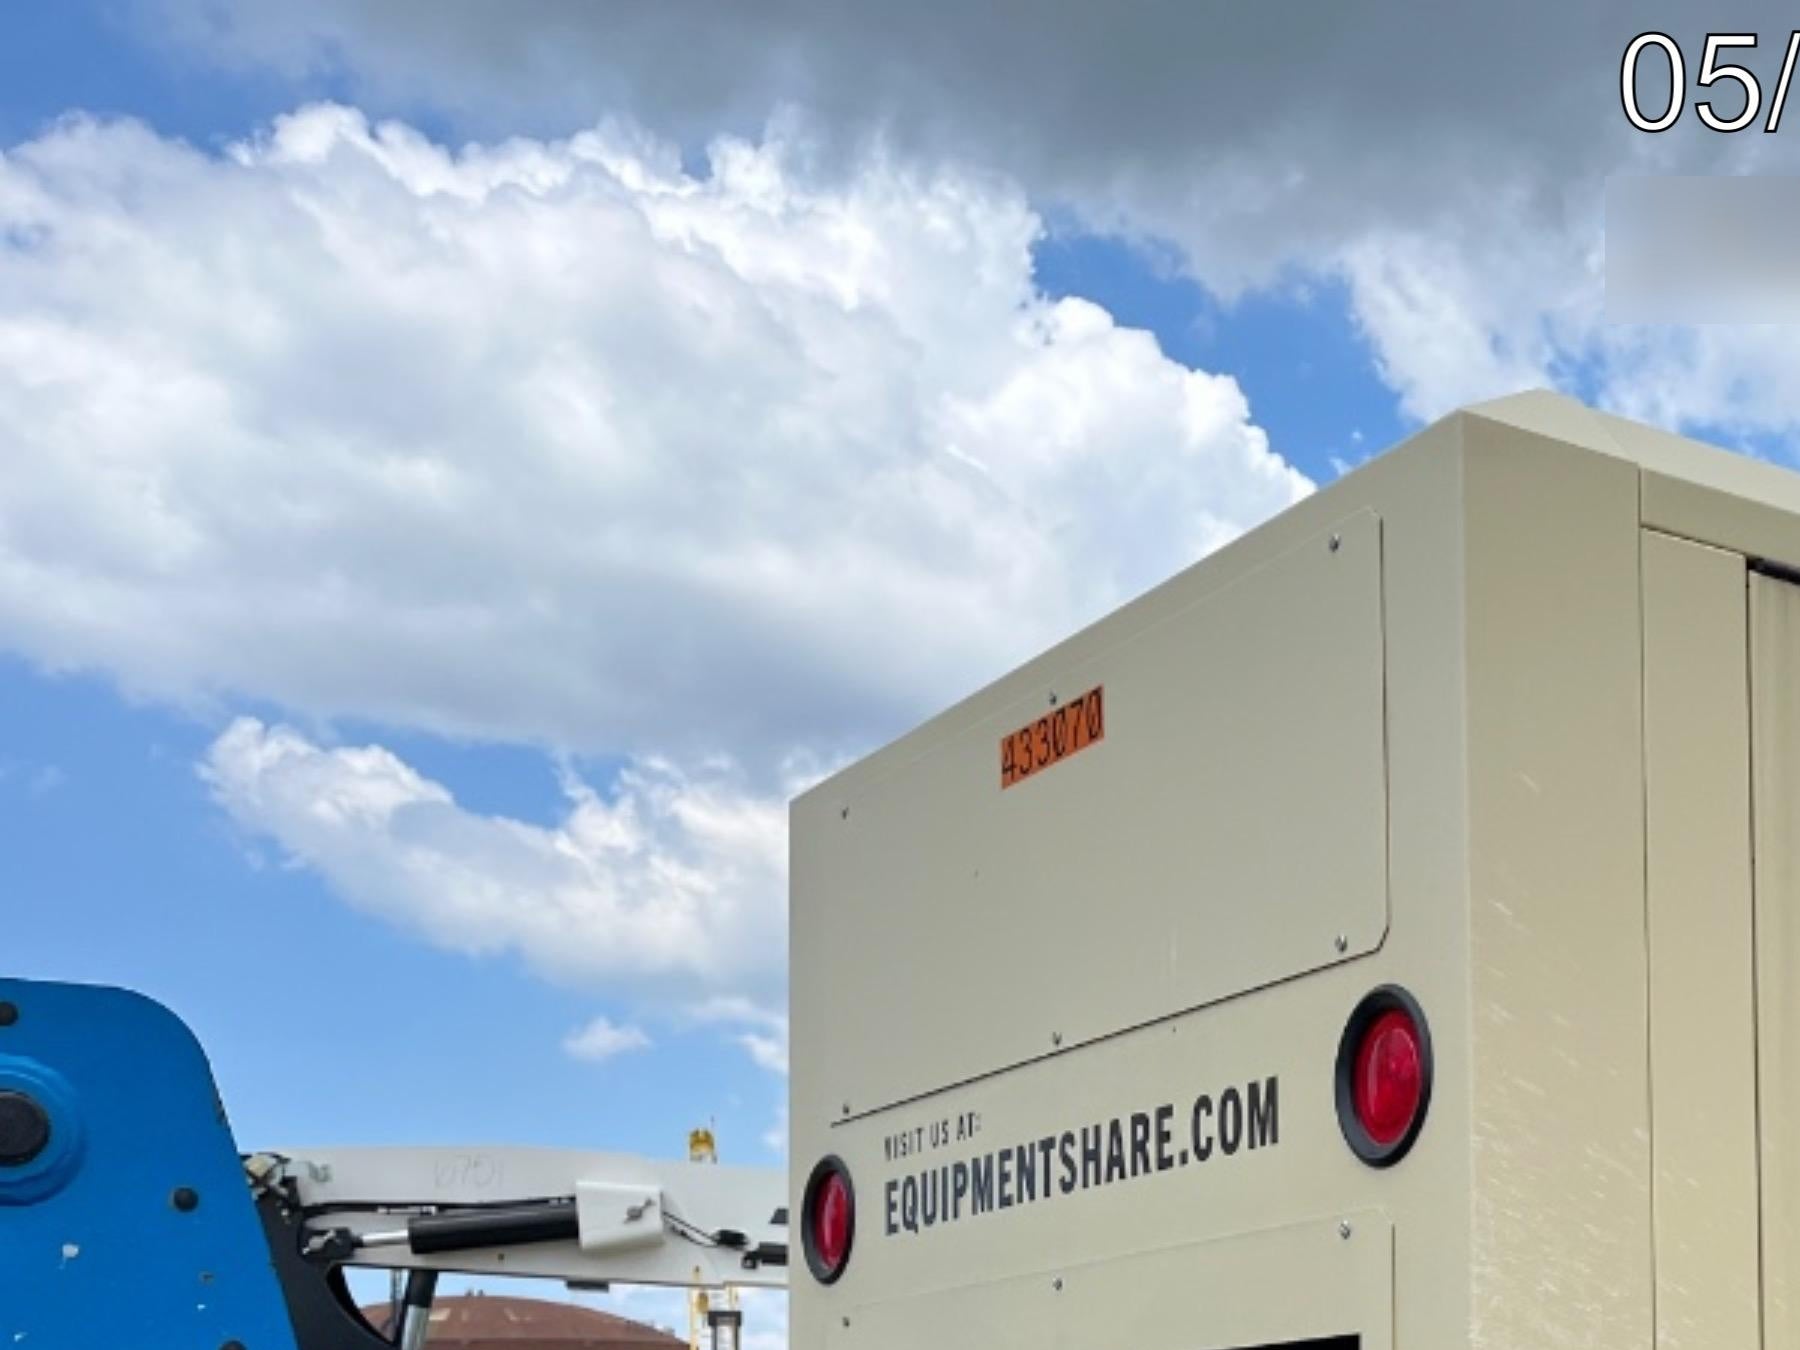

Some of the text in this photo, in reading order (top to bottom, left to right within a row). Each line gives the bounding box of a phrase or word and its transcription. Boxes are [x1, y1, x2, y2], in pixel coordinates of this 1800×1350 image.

[1001, 685, 1103, 782] 433070
[884, 1127, 924, 1161] VISIT
[929, 1119, 949, 1149] US
[885, 1075, 1279, 1237] EQUIPMENTSHARE.COM
